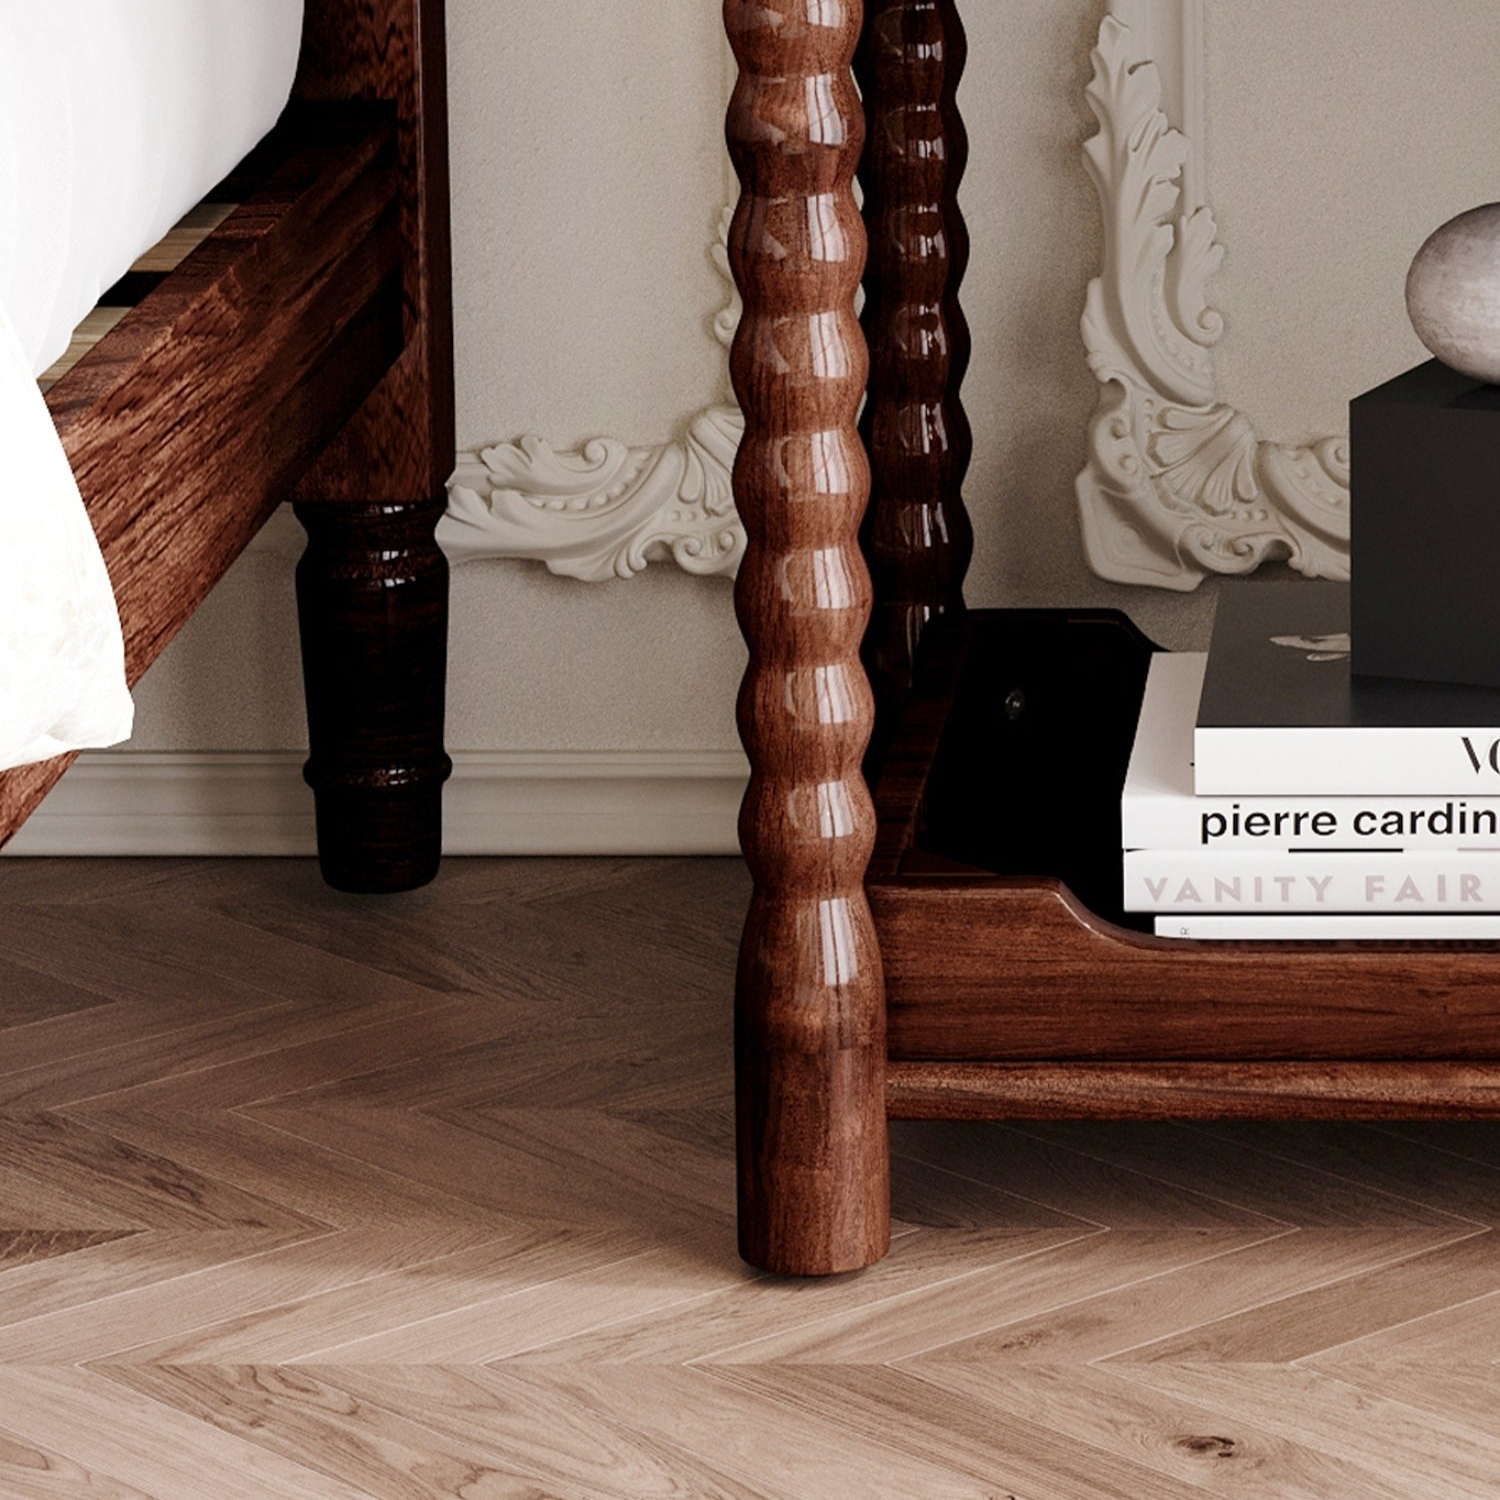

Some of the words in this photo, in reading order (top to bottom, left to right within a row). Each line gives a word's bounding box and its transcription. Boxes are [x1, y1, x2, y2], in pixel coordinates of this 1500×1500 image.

[1201, 803, 1338, 845] pierre
[1353, 802, 1498, 836] cardin
[1143, 875, 1334, 902] VANITY
[1364, 874, 1483, 902] FAIR
